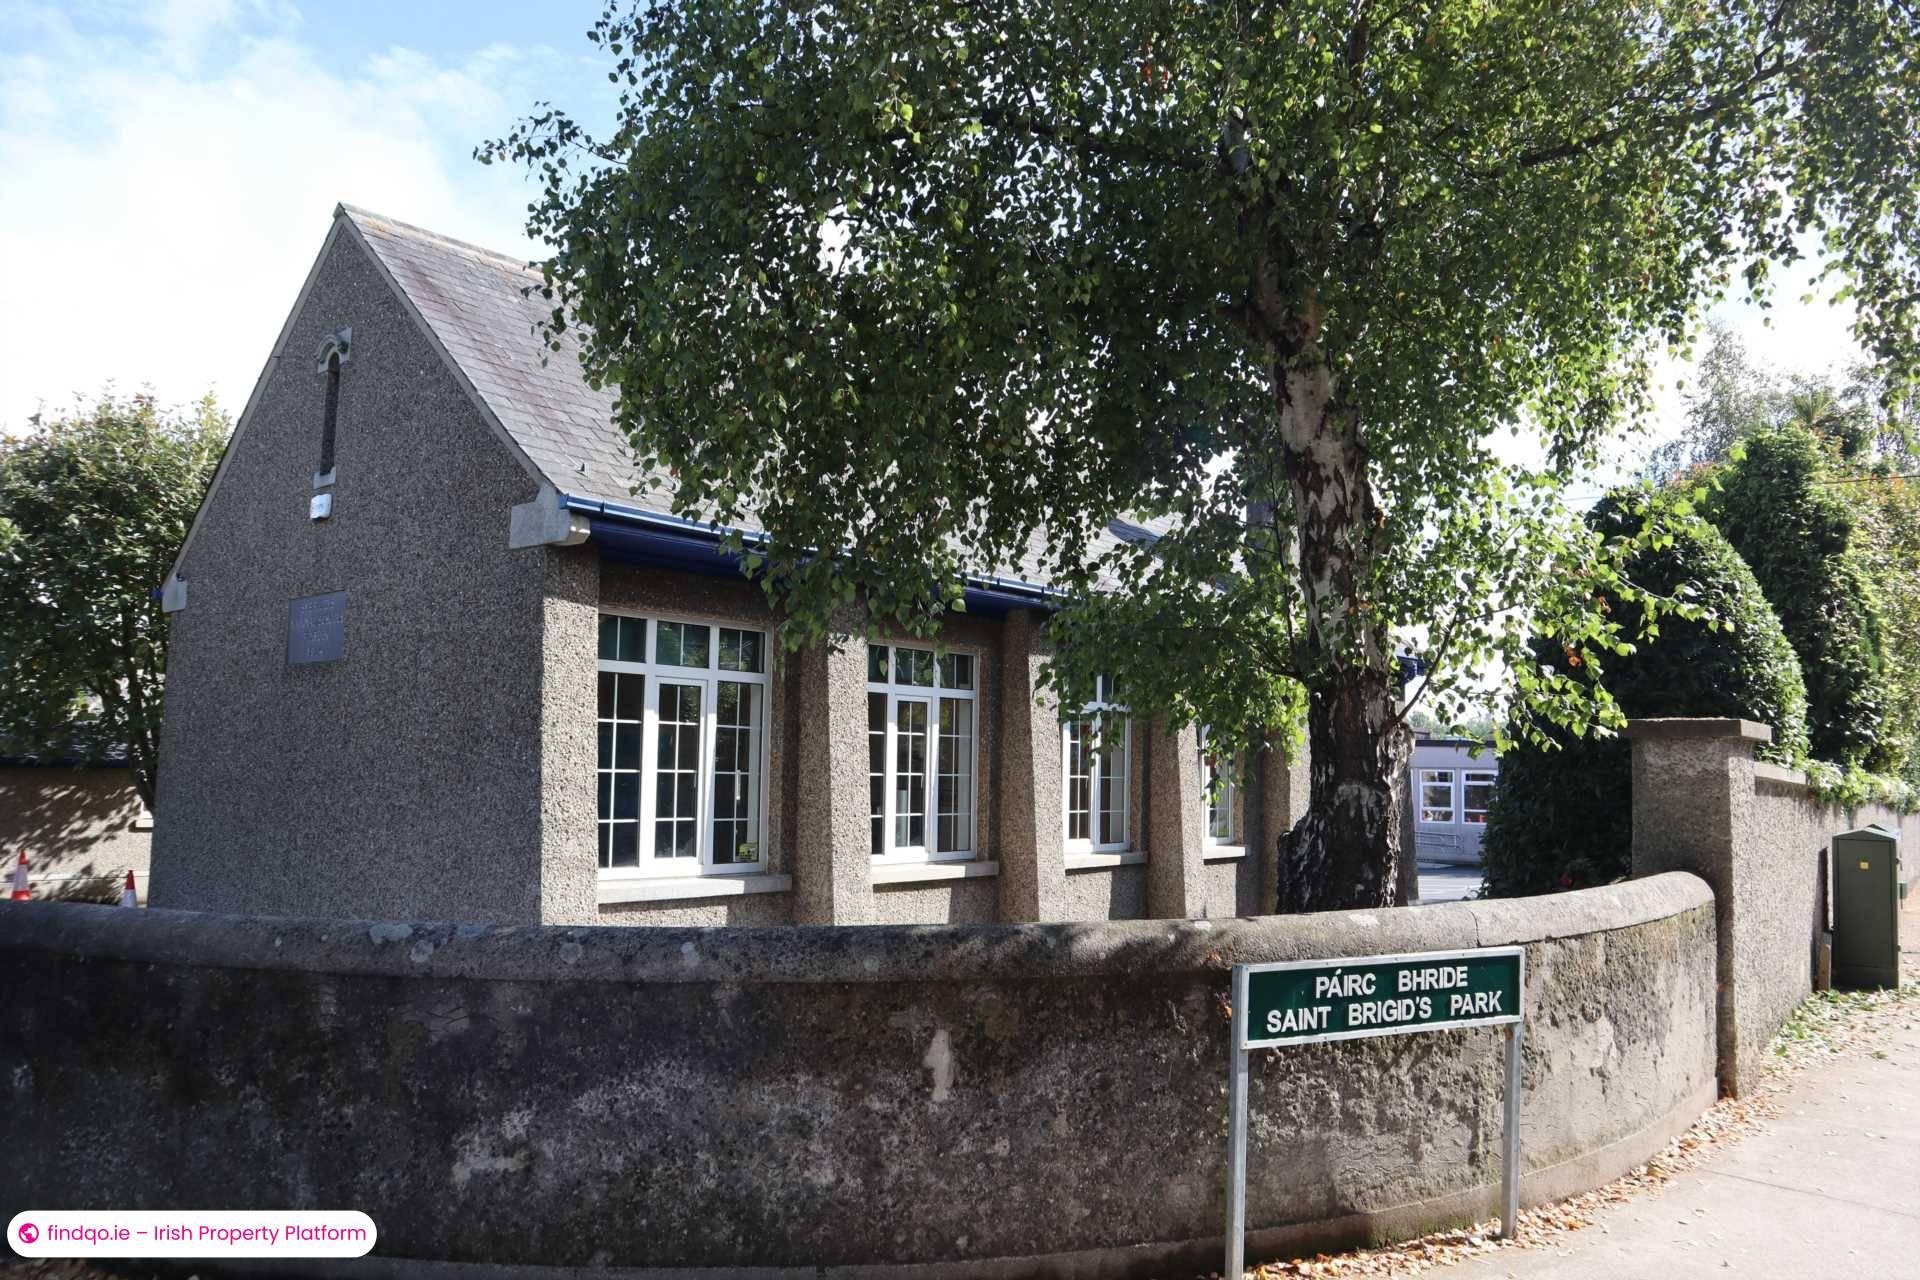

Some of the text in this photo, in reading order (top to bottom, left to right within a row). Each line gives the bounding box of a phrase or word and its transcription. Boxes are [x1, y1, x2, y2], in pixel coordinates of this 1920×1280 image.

[1315, 966, 1469, 999] PÁIRC BHRIDE
[1266, 990, 1503, 1033] SAINT BRIGID'S PARK
